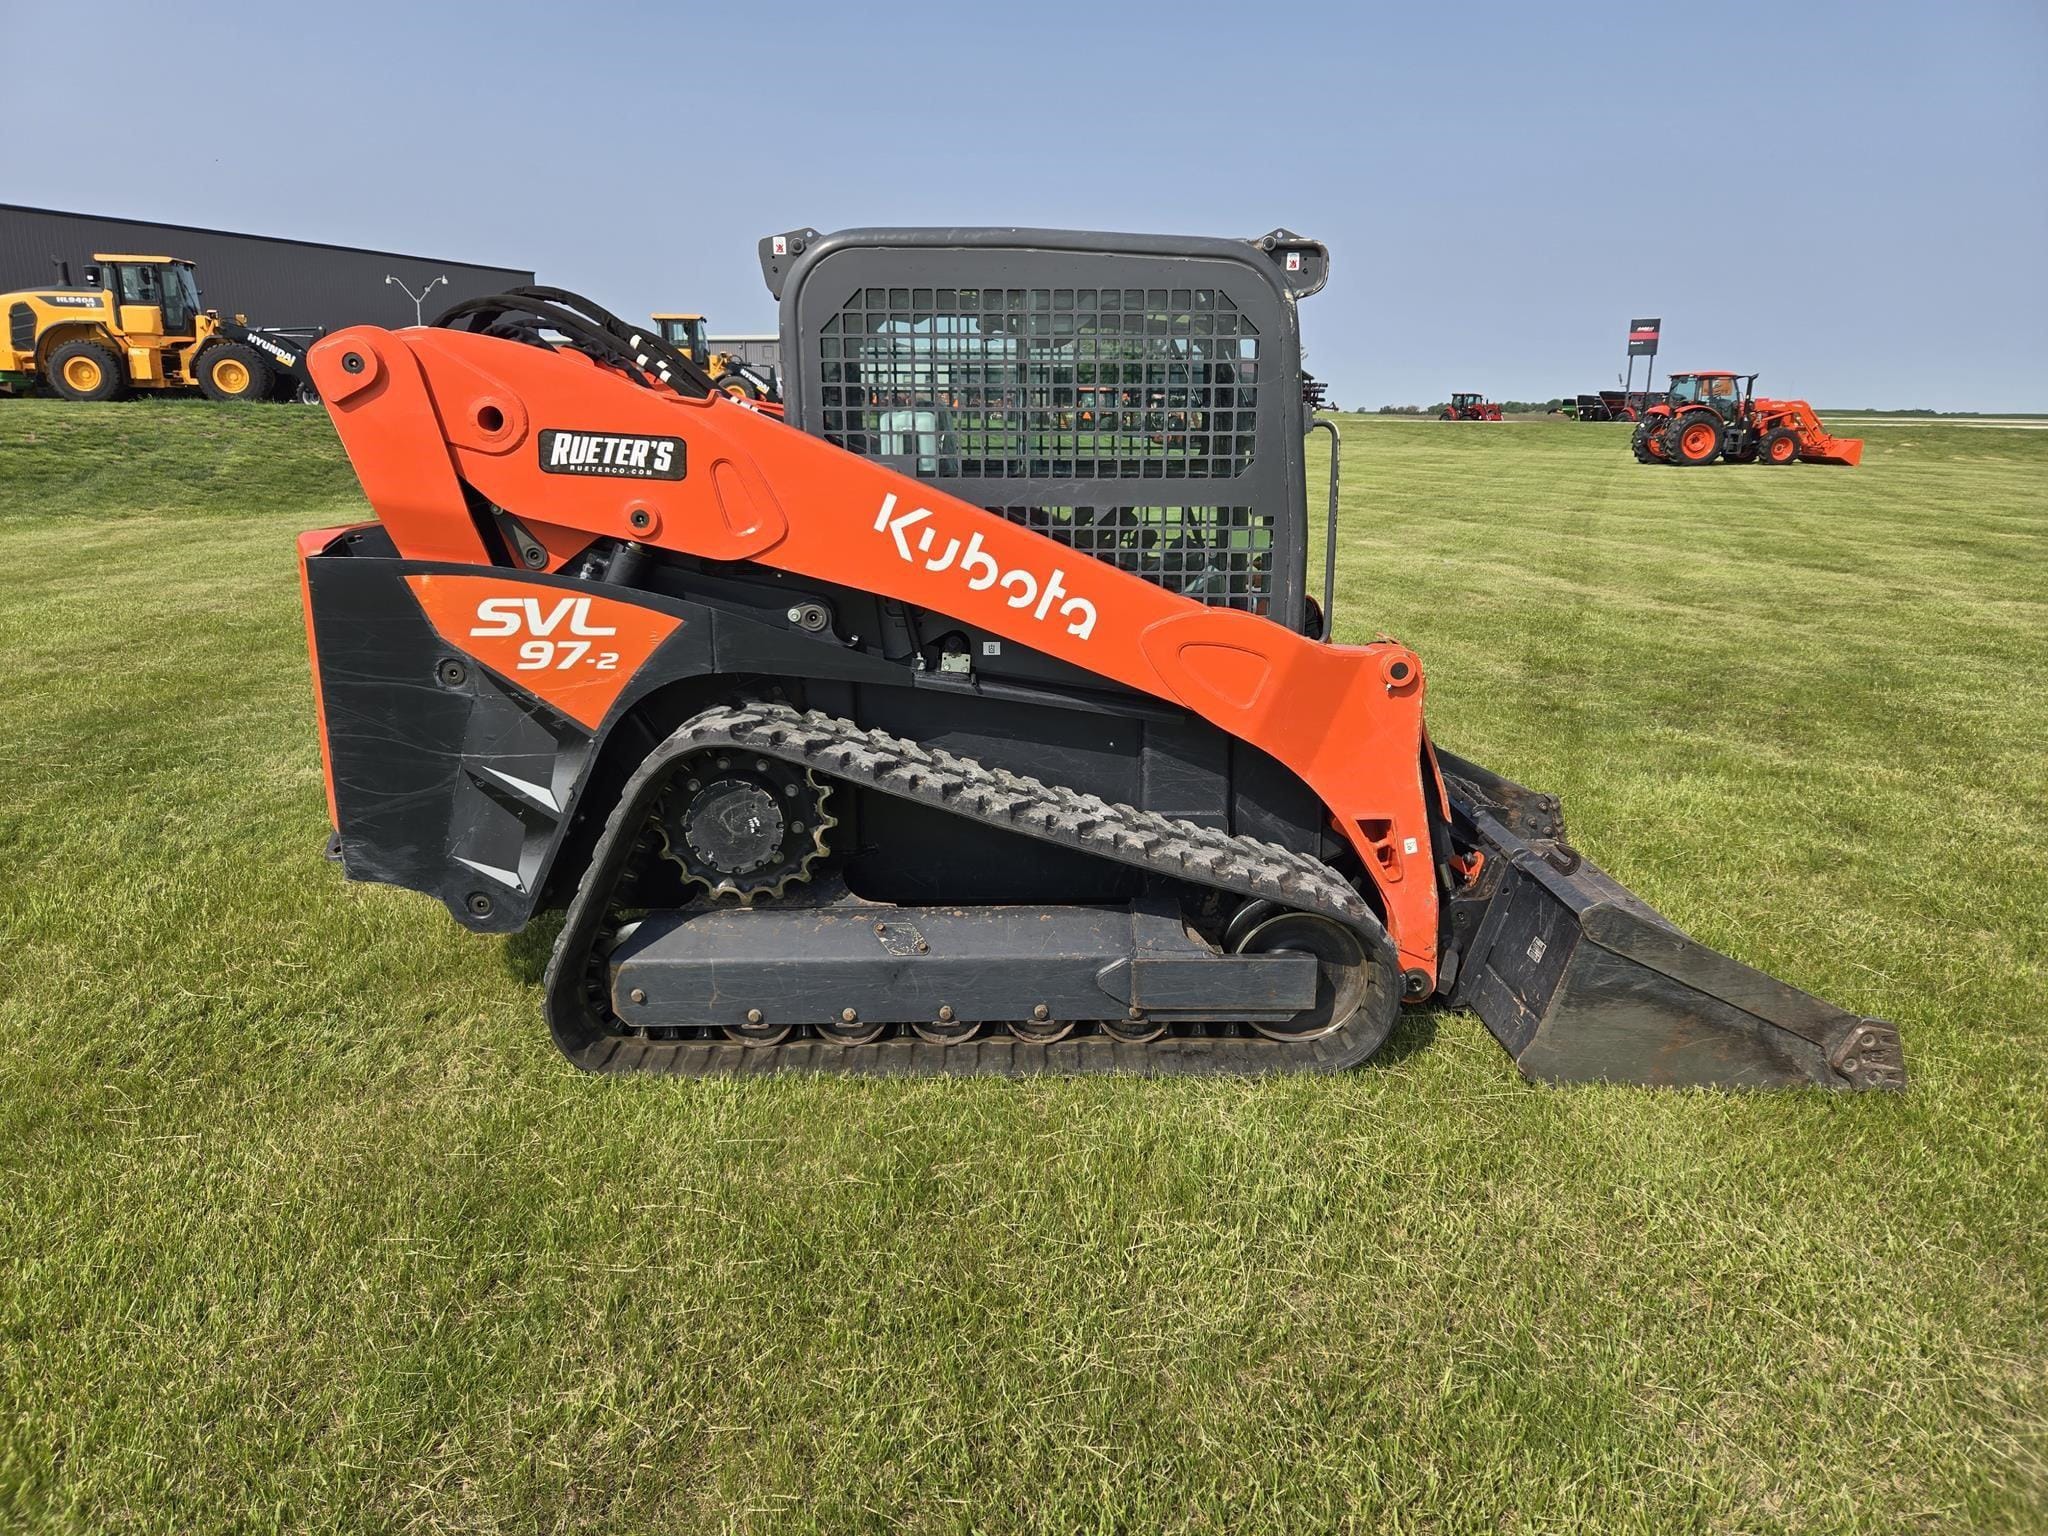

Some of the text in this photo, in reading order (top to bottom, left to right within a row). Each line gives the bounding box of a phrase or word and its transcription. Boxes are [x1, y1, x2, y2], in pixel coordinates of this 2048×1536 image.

[247, 333, 297, 363] HYUNDAI
[550, 432, 674, 472] RUETER'S
[570, 465, 653, 476] RUETERCO.COM
[873, 492, 1097, 641] Kubota
[469, 597, 617, 637] SVL
[517, 640, 620, 670] 97-2
